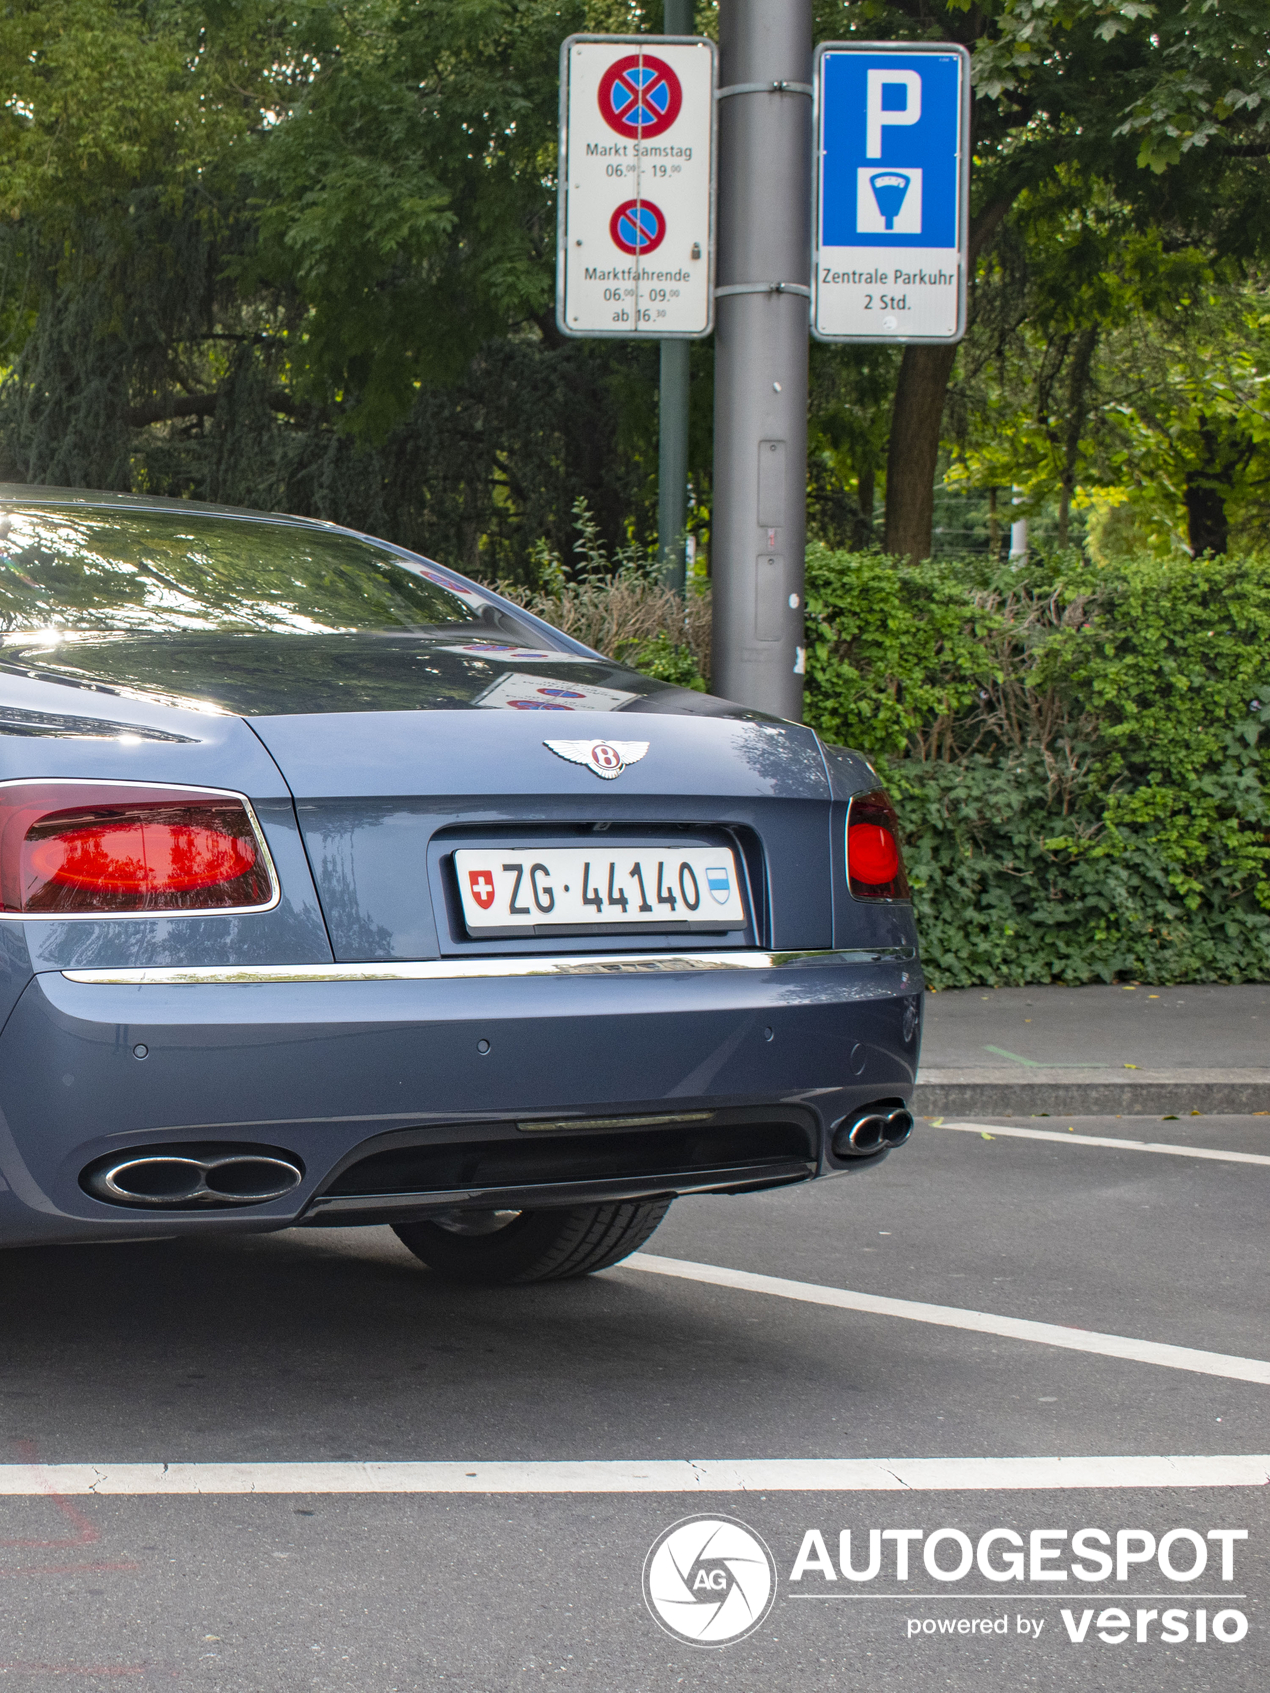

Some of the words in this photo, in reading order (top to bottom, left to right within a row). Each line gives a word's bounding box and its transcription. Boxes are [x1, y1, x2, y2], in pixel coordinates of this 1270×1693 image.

[866, 69, 922, 159] P
[585, 142, 628, 157] Markt
[632, 143, 693, 161] Samstag
[584, 267, 691, 282] Marktfahrende
[822, 268, 888, 284] Zentrale
[893, 269, 955, 285] Parkuhr
[864, 294, 874, 310] 2
[879, 294, 911, 310] Std.
[612, 308, 629, 322] ab
[594, 746, 618, 768] B
